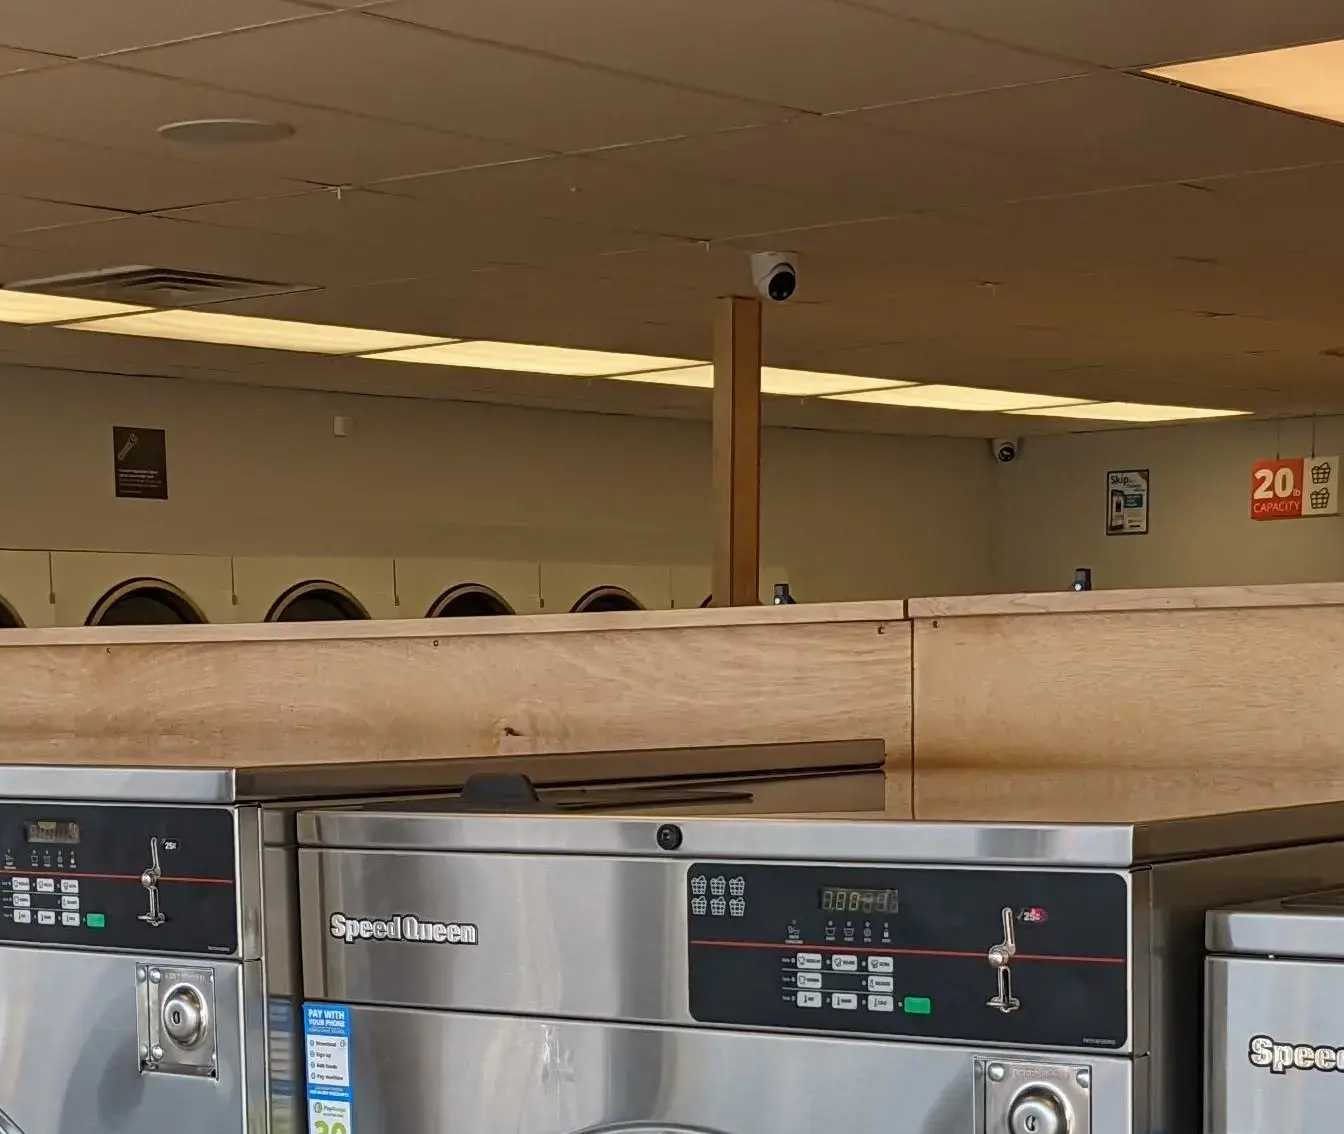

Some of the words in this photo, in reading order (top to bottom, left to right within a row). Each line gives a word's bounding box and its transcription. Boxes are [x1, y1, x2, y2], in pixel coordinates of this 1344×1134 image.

[1253, 467, 1294, 500] 20
[1293, 488, 1301, 497] lb
[1253, 500, 1300, 513] CAPACITY
[331, 913, 401, 943] Speed
[402, 915, 477, 944] Queen
[308, 1008, 322, 1018] PAY
[324, 1010, 345, 1020] WITH
